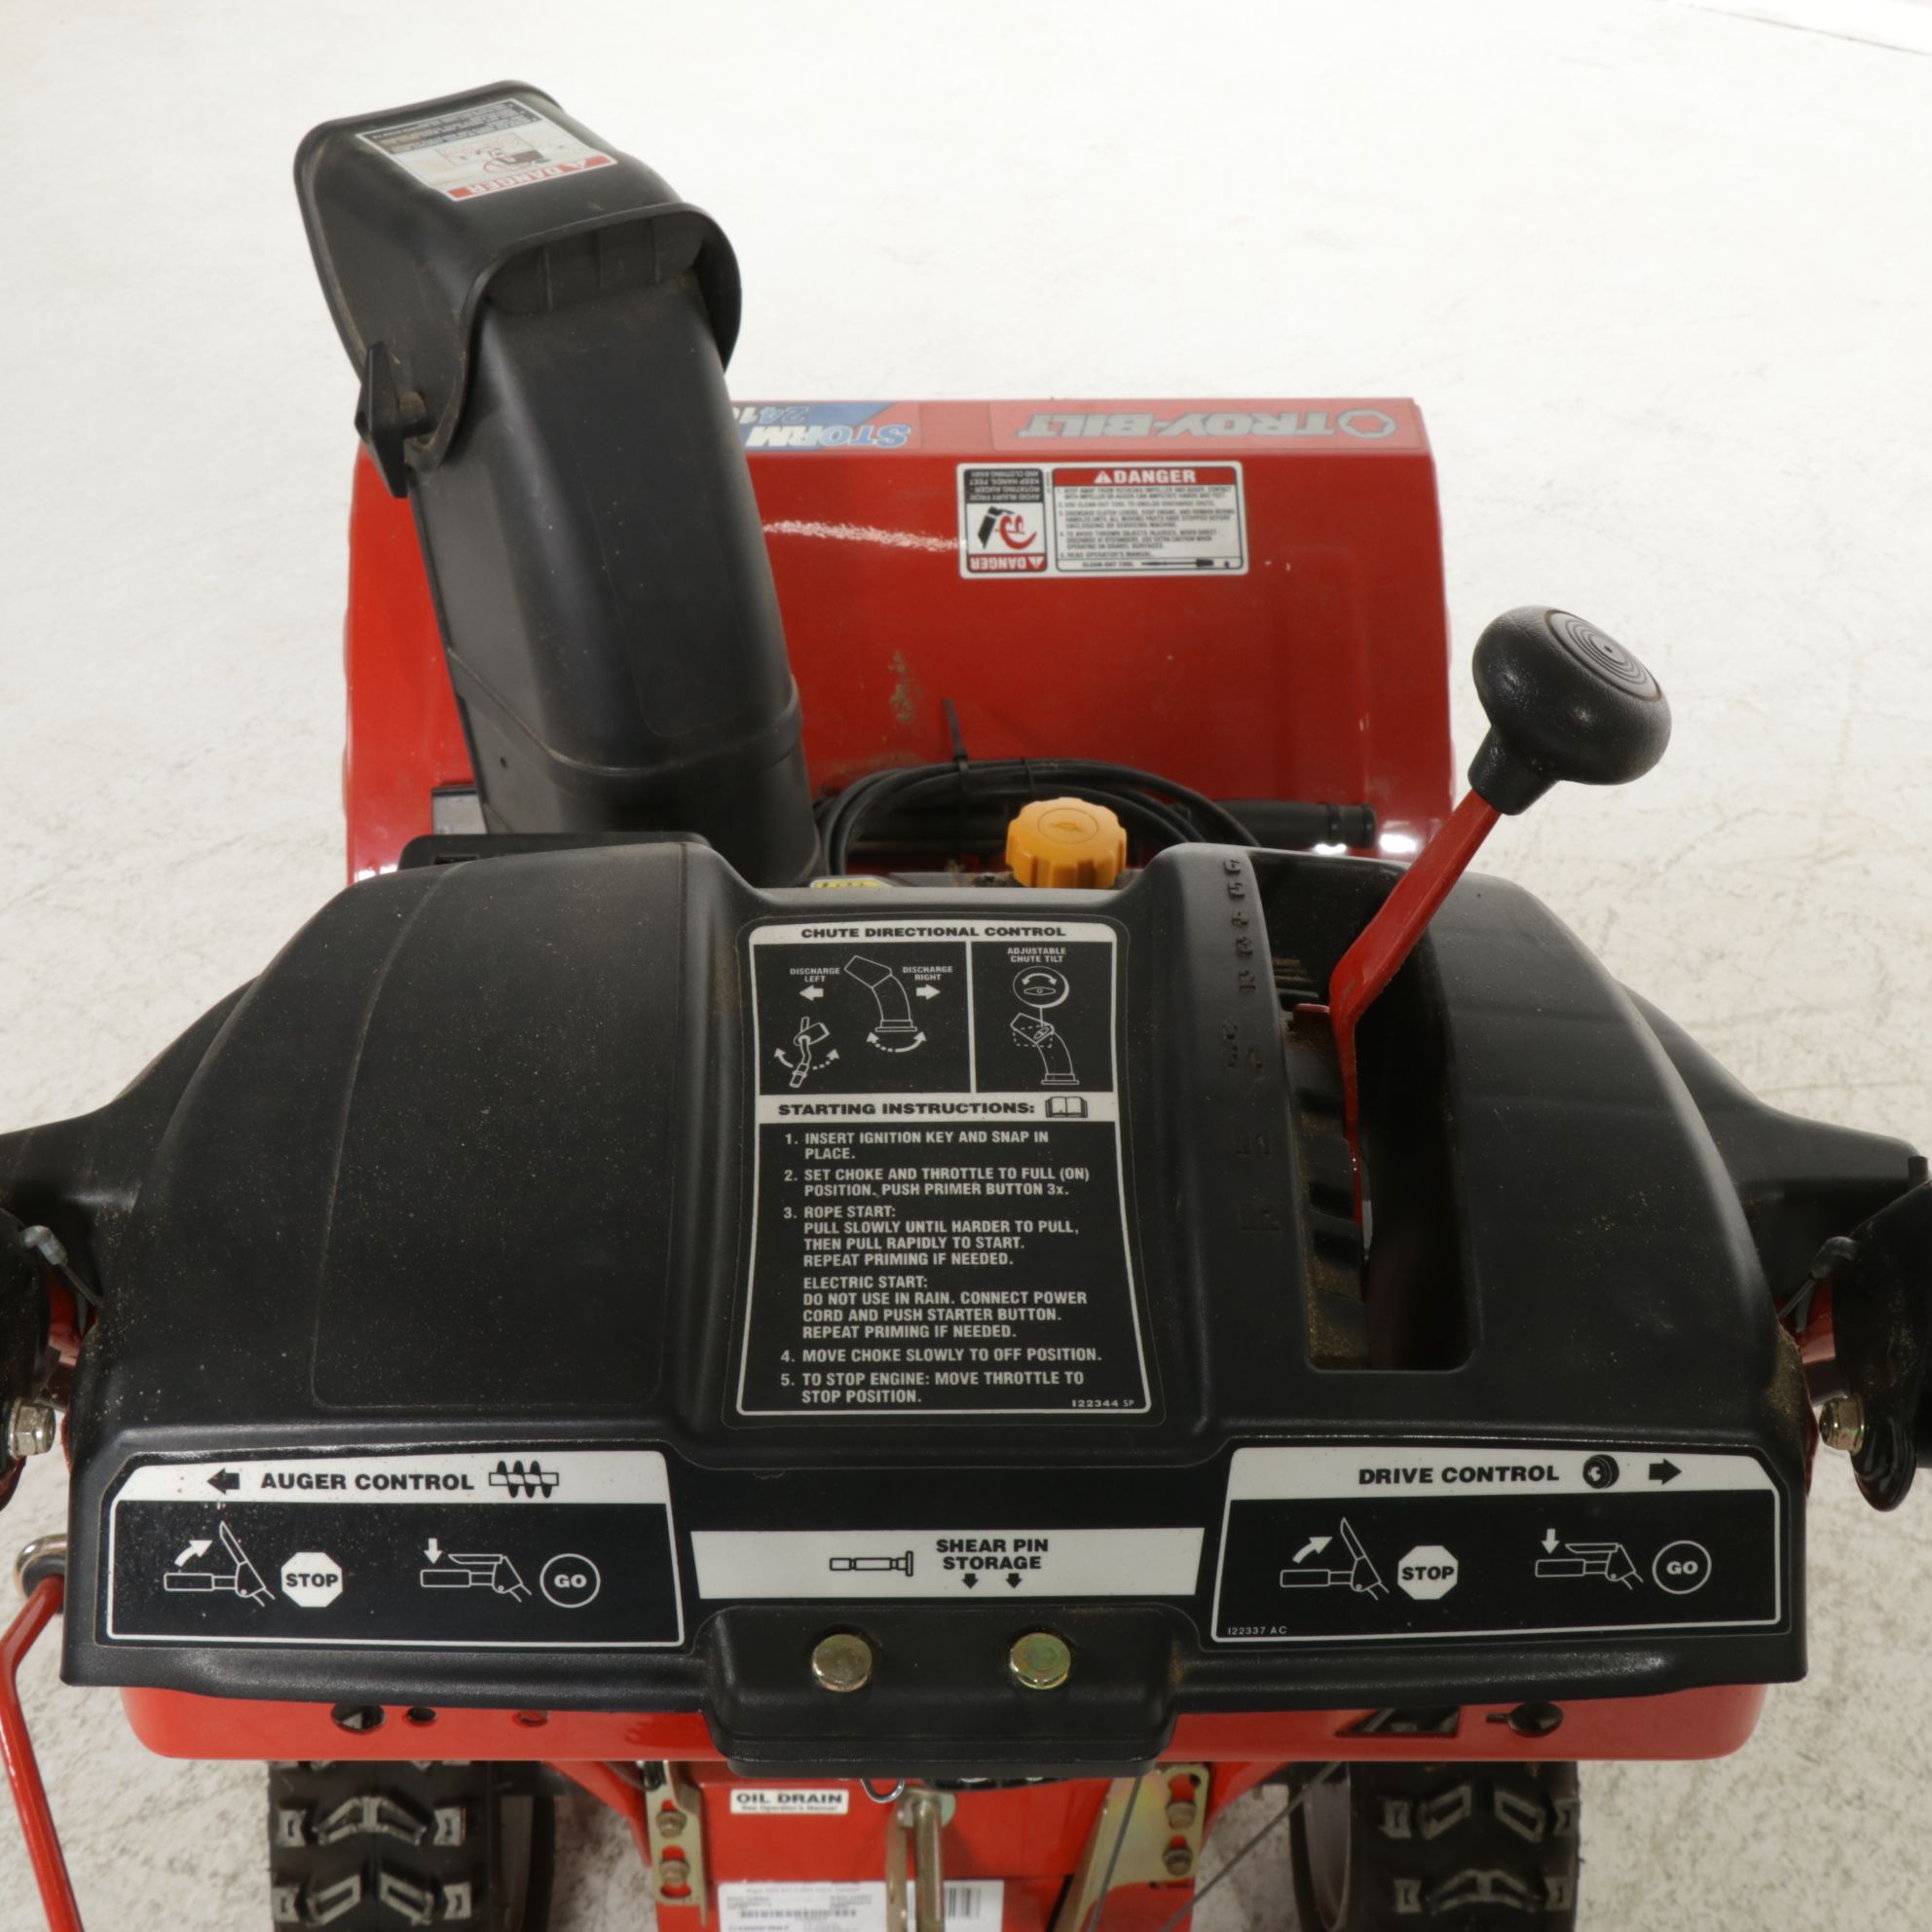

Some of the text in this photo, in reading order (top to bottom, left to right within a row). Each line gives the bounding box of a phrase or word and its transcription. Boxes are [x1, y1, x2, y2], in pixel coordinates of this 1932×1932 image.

[1017, 411, 1335, 437] TROY-BILT
[745, 424, 911, 449] STORM
[1113, 469, 1196, 484] DANGER
[970, 557, 1026, 570] DANGER
[800, 927, 1066, 939] CHUTE DIRECTIONAL CONTROL
[1007, 947, 1066, 955] ADJUSTABLE
[790, 967, 840, 976] DISCHARGE
[778, 1102, 1034, 1116] STARTING INSTRUCTIONS:
[785, 1131, 1049, 1144] 1. INSERT IGNITION KEY AND SNAP IN
[804, 1147, 855, 1160] PLACE.
[784, 1167, 1090, 1182] 2. SET CHOKE AND THROTTLE TO FULL (ON)
[804, 1184, 876, 1197] POSITION.
[881, 1183, 920, 1196] PUSH
[924, 1182, 982, 1195] PRIMER
[985, 1182, 1043, 1195] BUTTON
[784, 1205, 896, 1219] 3. ROPE START:
[804, 1220, 1079, 1235] PULL SLOWLY UNTIL HARDER TO PULL,
[804, 1236, 1024, 1250] THEN PULL RAPIDLY TO START.
[803, 1252, 1013, 1267] REPEAT PRIMING IF NEEDED.
[803, 1276, 927, 1289] ELECTRIC START:
[803, 1291, 1087, 1306] DO NOT USE IN RAIN. CONNECT POWER
[802, 1308, 1061, 1322] CORD AND PUSH STARTER BUTTON.
[802, 1324, 1016, 1339] REPEAT PRIMING IF NEEDED.
[781, 1348, 1101, 1362] 4. MOVE CHOKE SLOWLY TO OFF POSITION.
[781, 1371, 1084, 1387] 5. TO STOP ENGINE: MOVE THROTTLE TO
[802, 1389, 921, 1403] STOP POSITION.
[1071, 1399, 1119, 1408] 122344
[261, 1472, 474, 1491] AUGER CONTROL
[1358, 1465, 1559, 1485] DRIVE CONTROL
[937, 1539, 1048, 1553] SHEAR PIN
[943, 1556, 1041, 1570] STORAGE
[1666, 1561, 1698, 1575] GO
[285, 1573, 340, 1587] STOP
[1402, 1566, 1455, 1580] STOP
[554, 1574, 587, 1588] GO
[736, 1794, 842, 1803] OIL DRAIN
